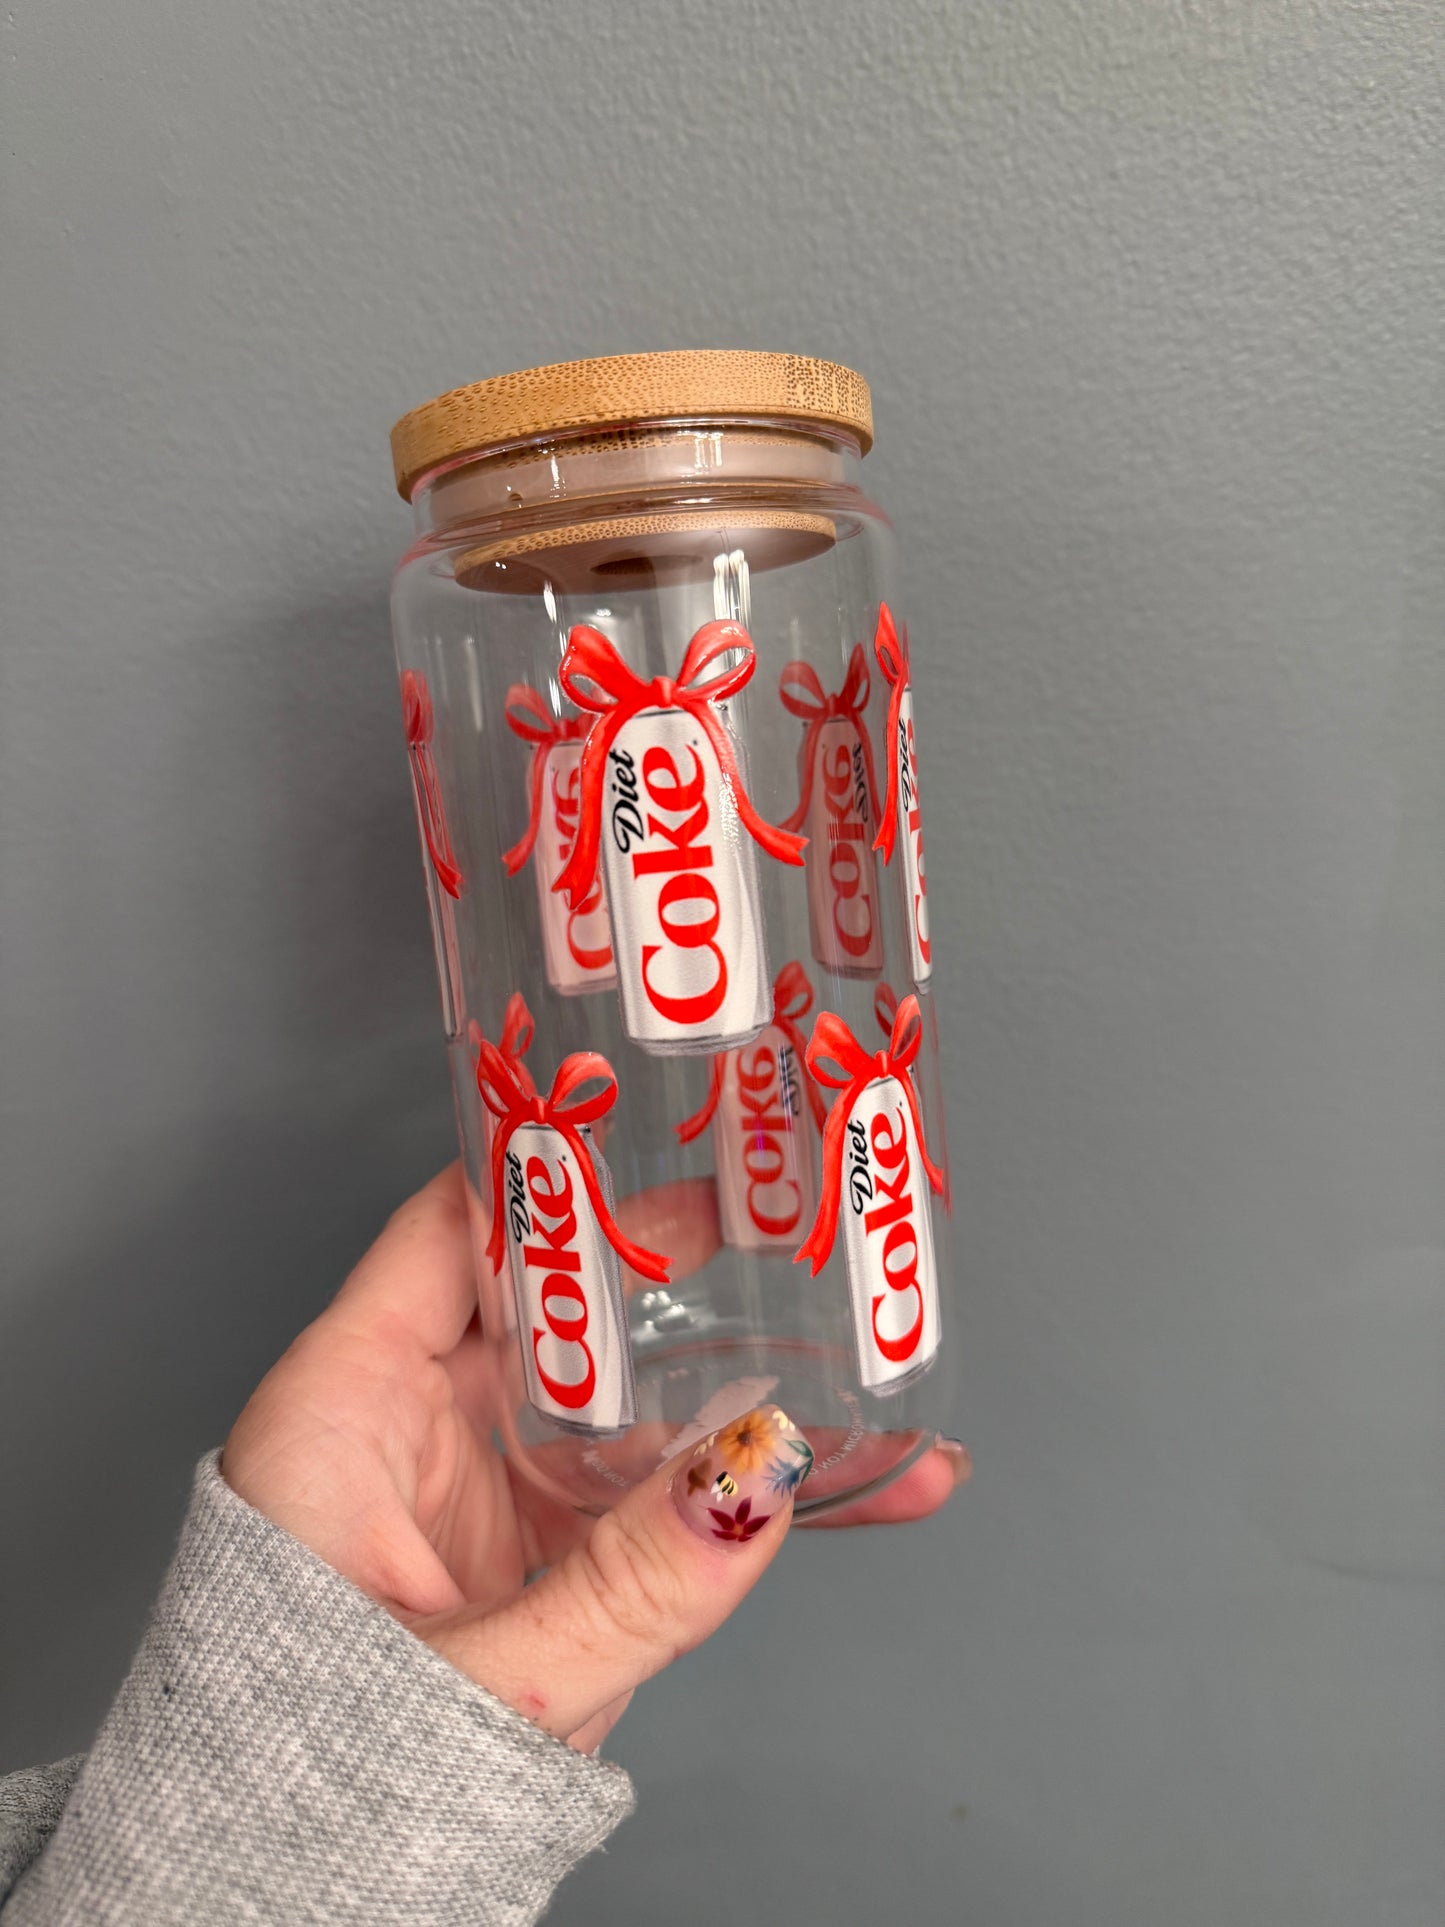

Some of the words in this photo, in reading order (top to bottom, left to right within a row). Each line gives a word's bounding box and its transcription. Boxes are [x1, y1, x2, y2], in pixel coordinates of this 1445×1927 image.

[608, 748, 645, 854] Diet
[898, 718, 912, 812] Diet
[632, 745, 729, 1026] Coke
[504, 1151, 532, 1244] Diet
[847, 1119, 874, 1216] Diet
[523, 1155, 597, 1411] Coke
[864, 1108, 924, 1363] Coke
